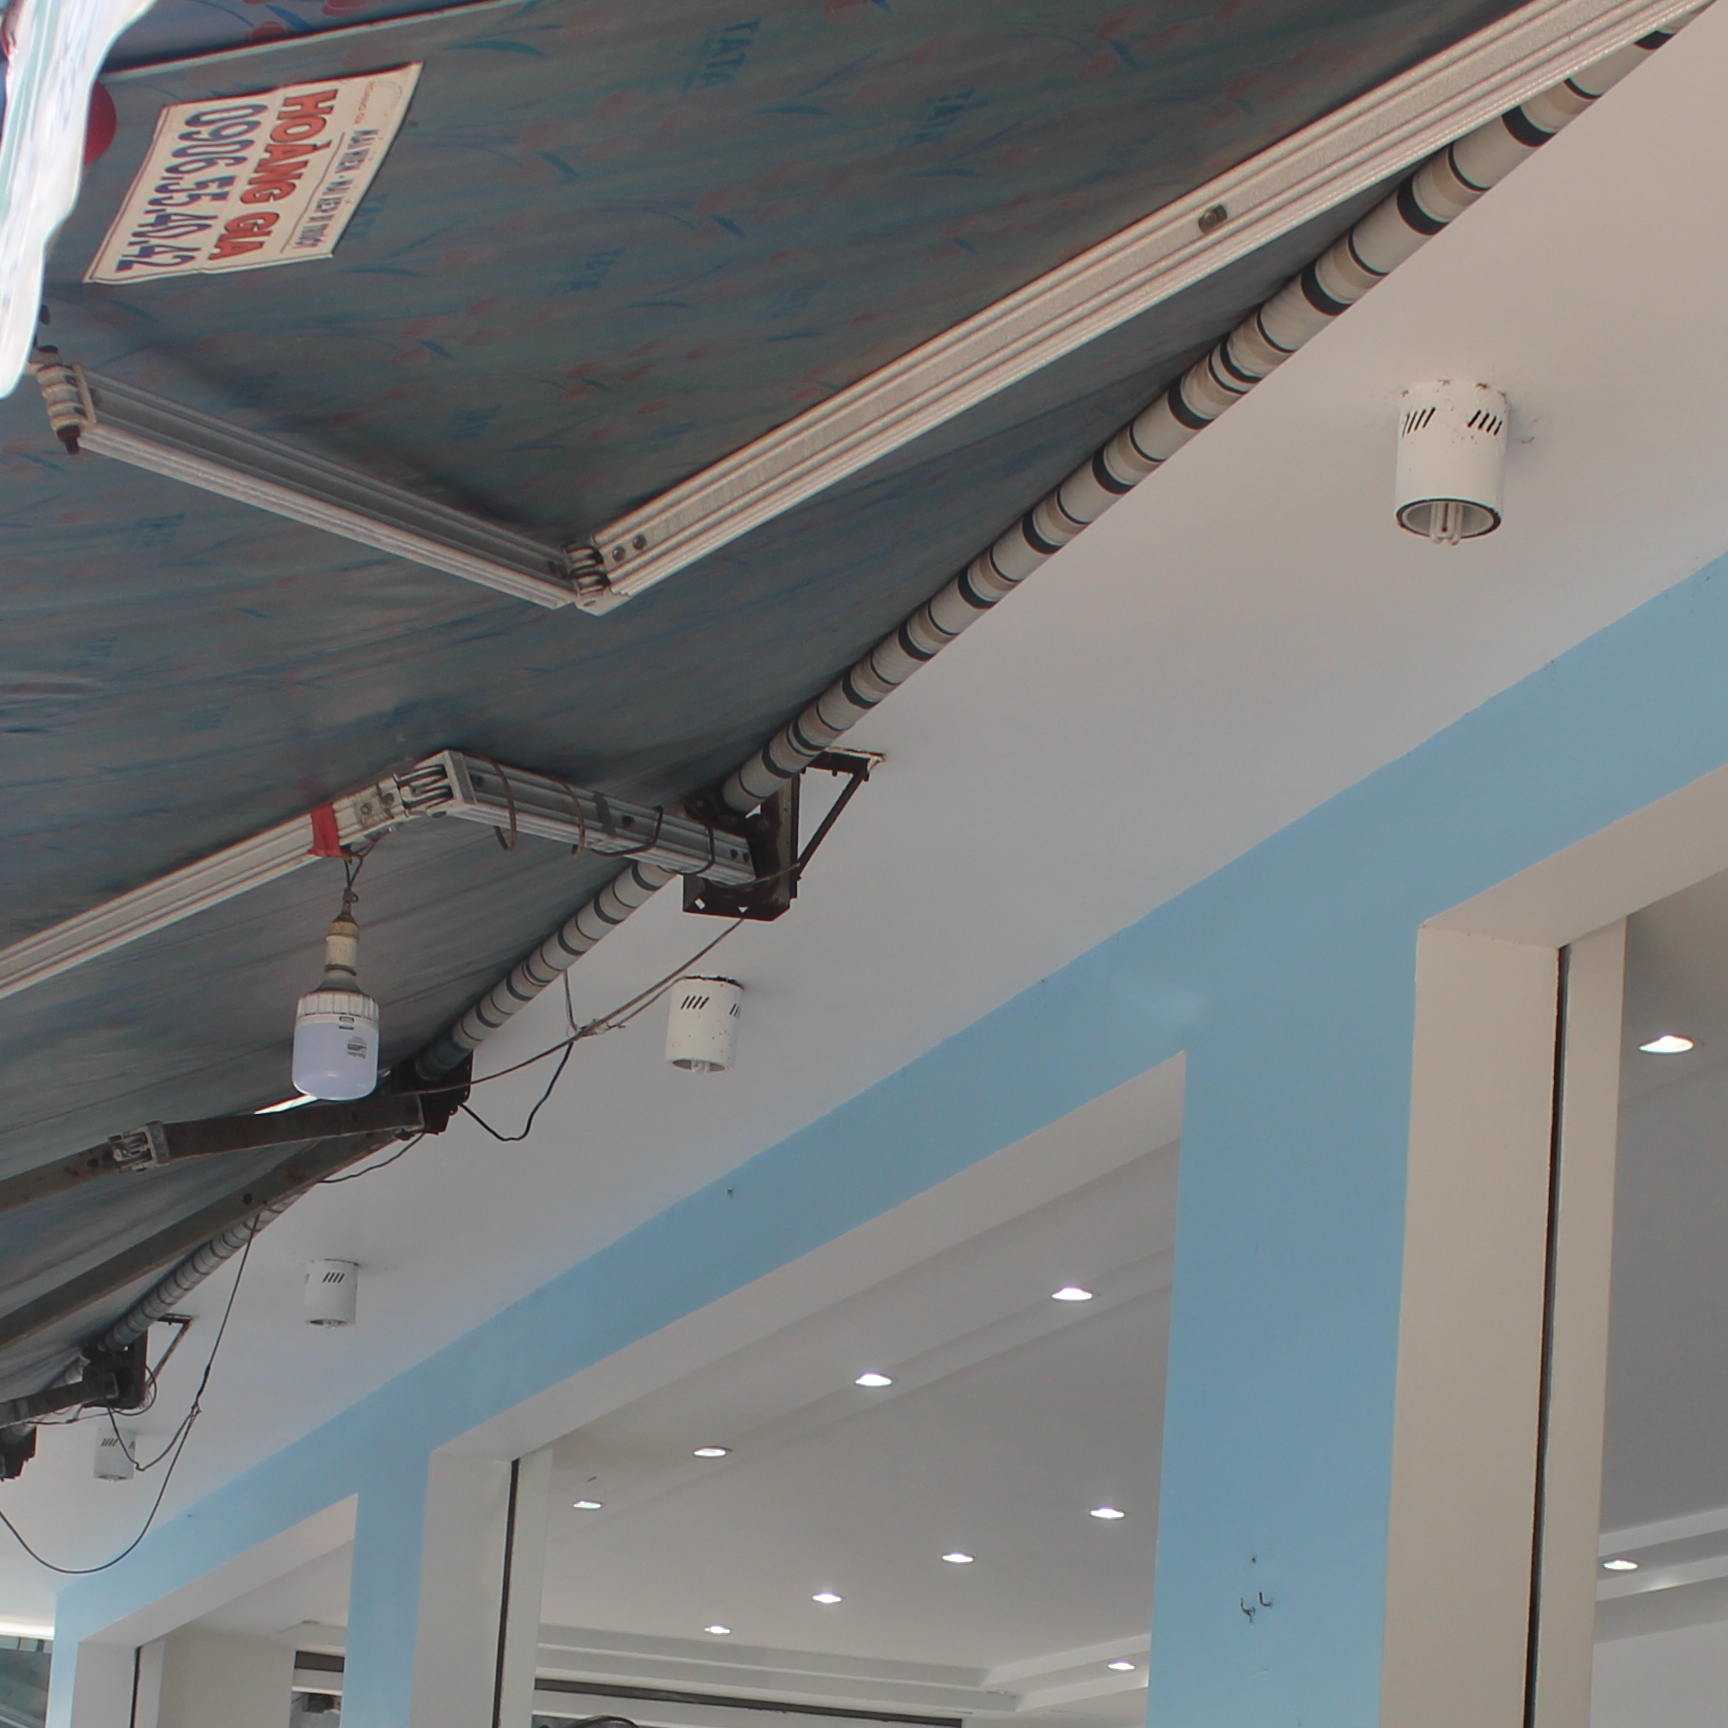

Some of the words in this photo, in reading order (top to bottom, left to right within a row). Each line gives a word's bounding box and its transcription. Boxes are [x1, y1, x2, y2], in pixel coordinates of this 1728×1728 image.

[114, 103, 269, 272] 0906.55.40.42
[239, 88, 339, 204] HOÀNG
[208, 210, 280, 261] GIA
